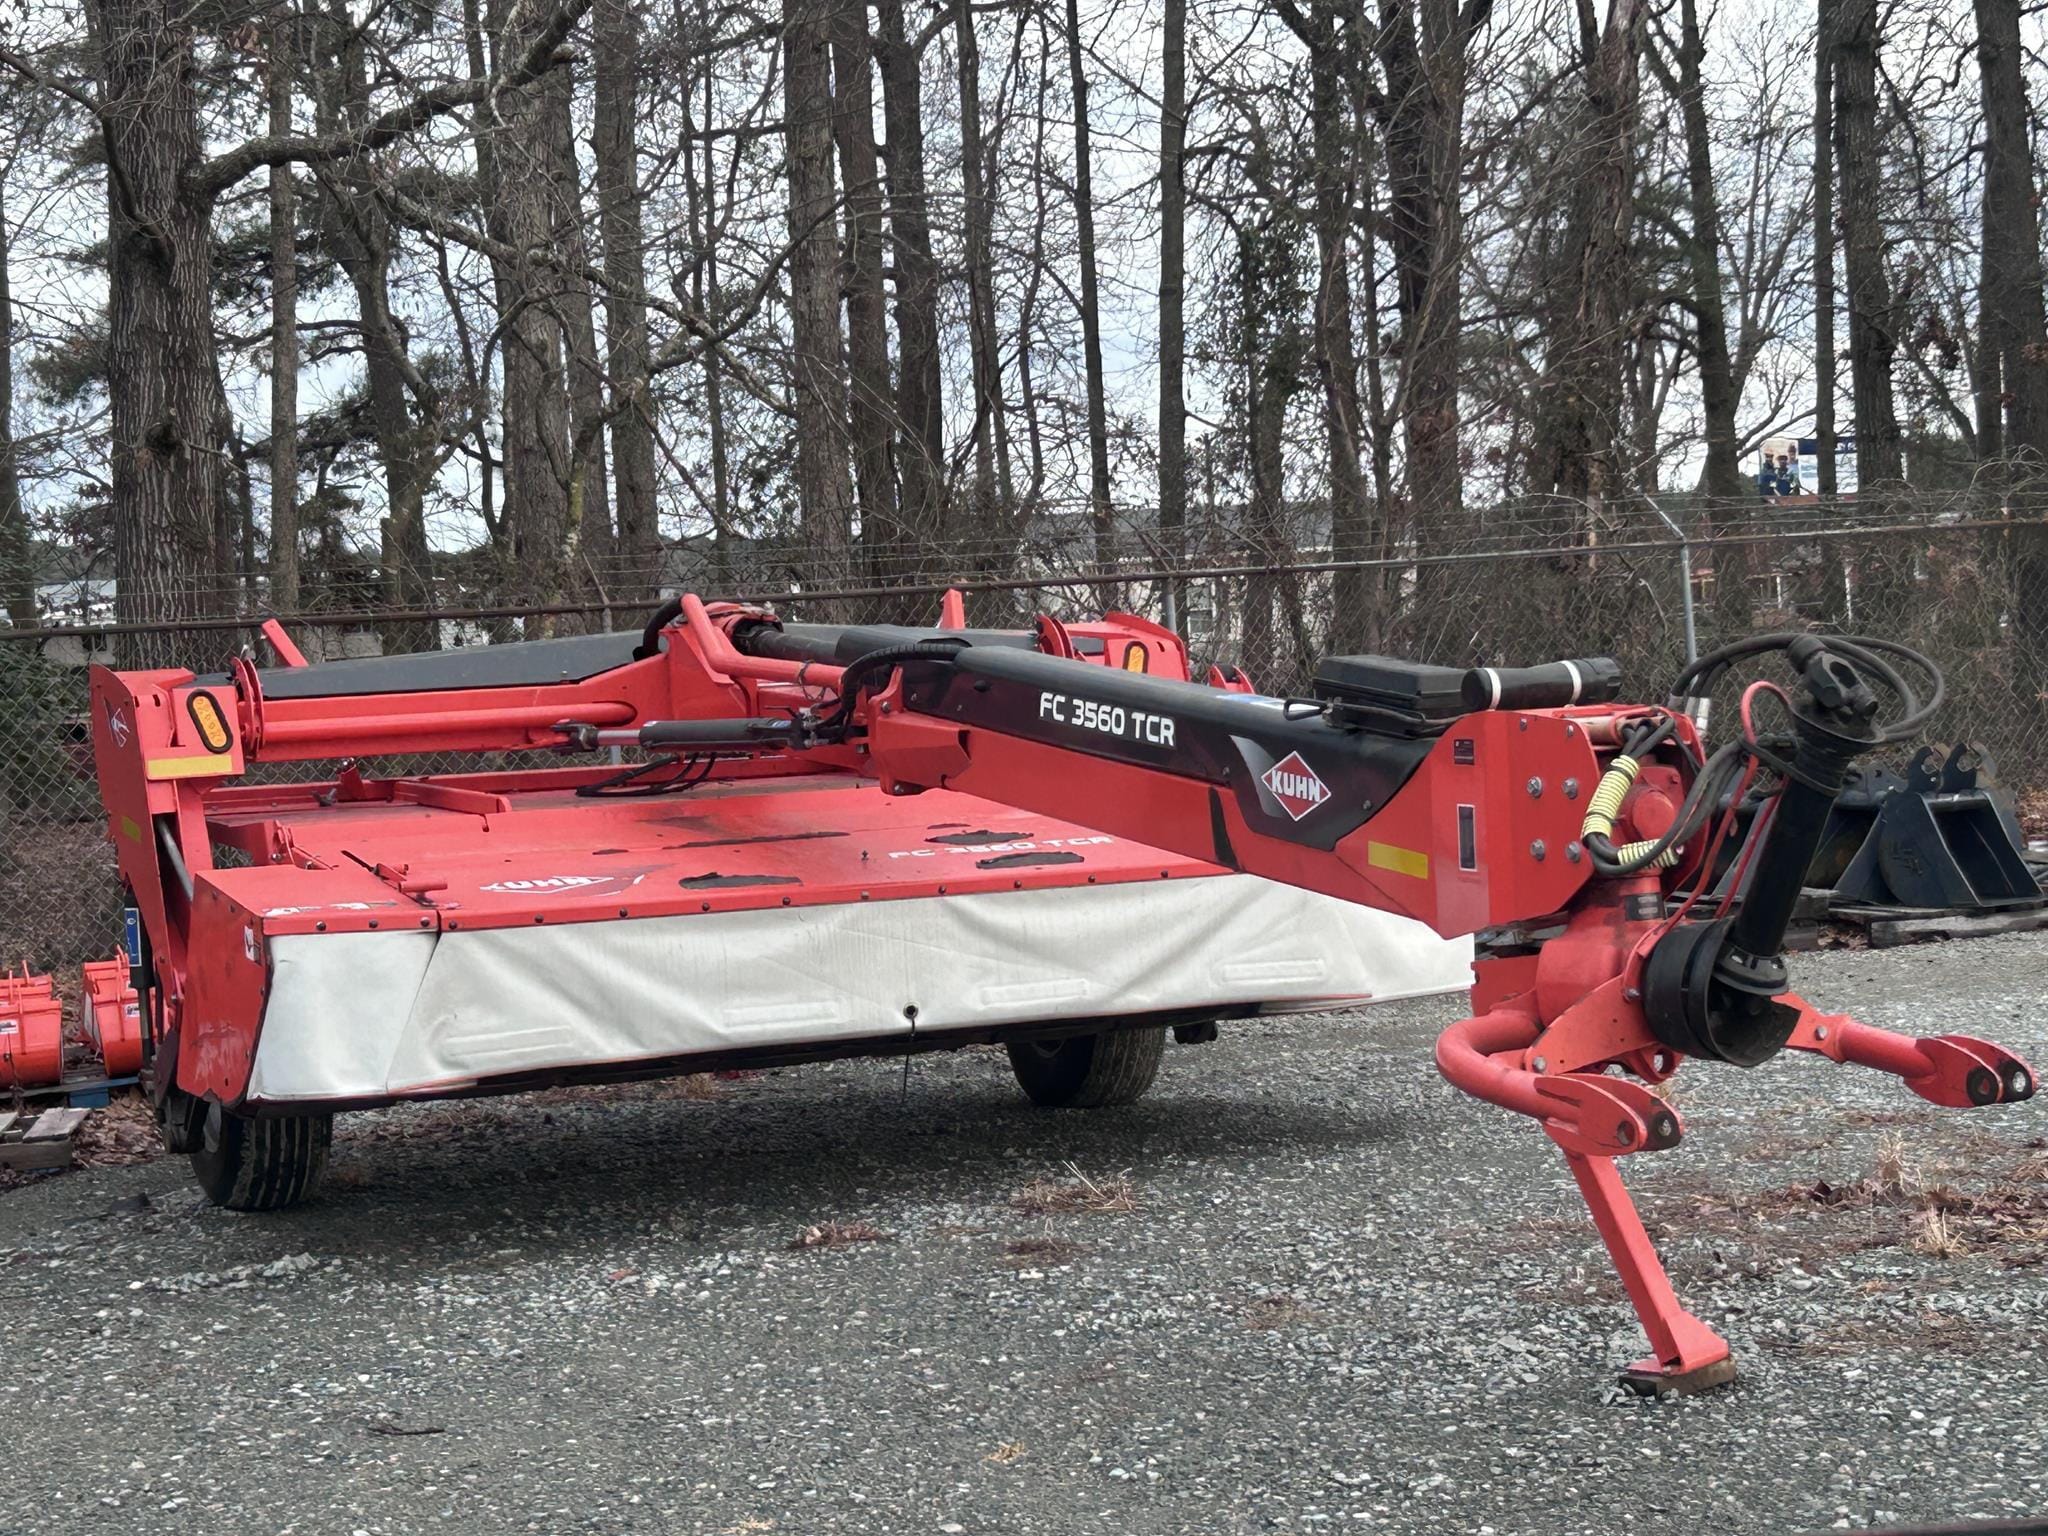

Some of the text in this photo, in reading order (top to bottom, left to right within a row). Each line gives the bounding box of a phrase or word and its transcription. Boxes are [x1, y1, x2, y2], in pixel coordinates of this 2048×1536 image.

[1039, 692, 1174, 746] FC 3560 TCR
[1270, 769, 1321, 803] KUHN
[888, 849, 935, 859] FC
[1042, 836, 1113, 847] TCR
